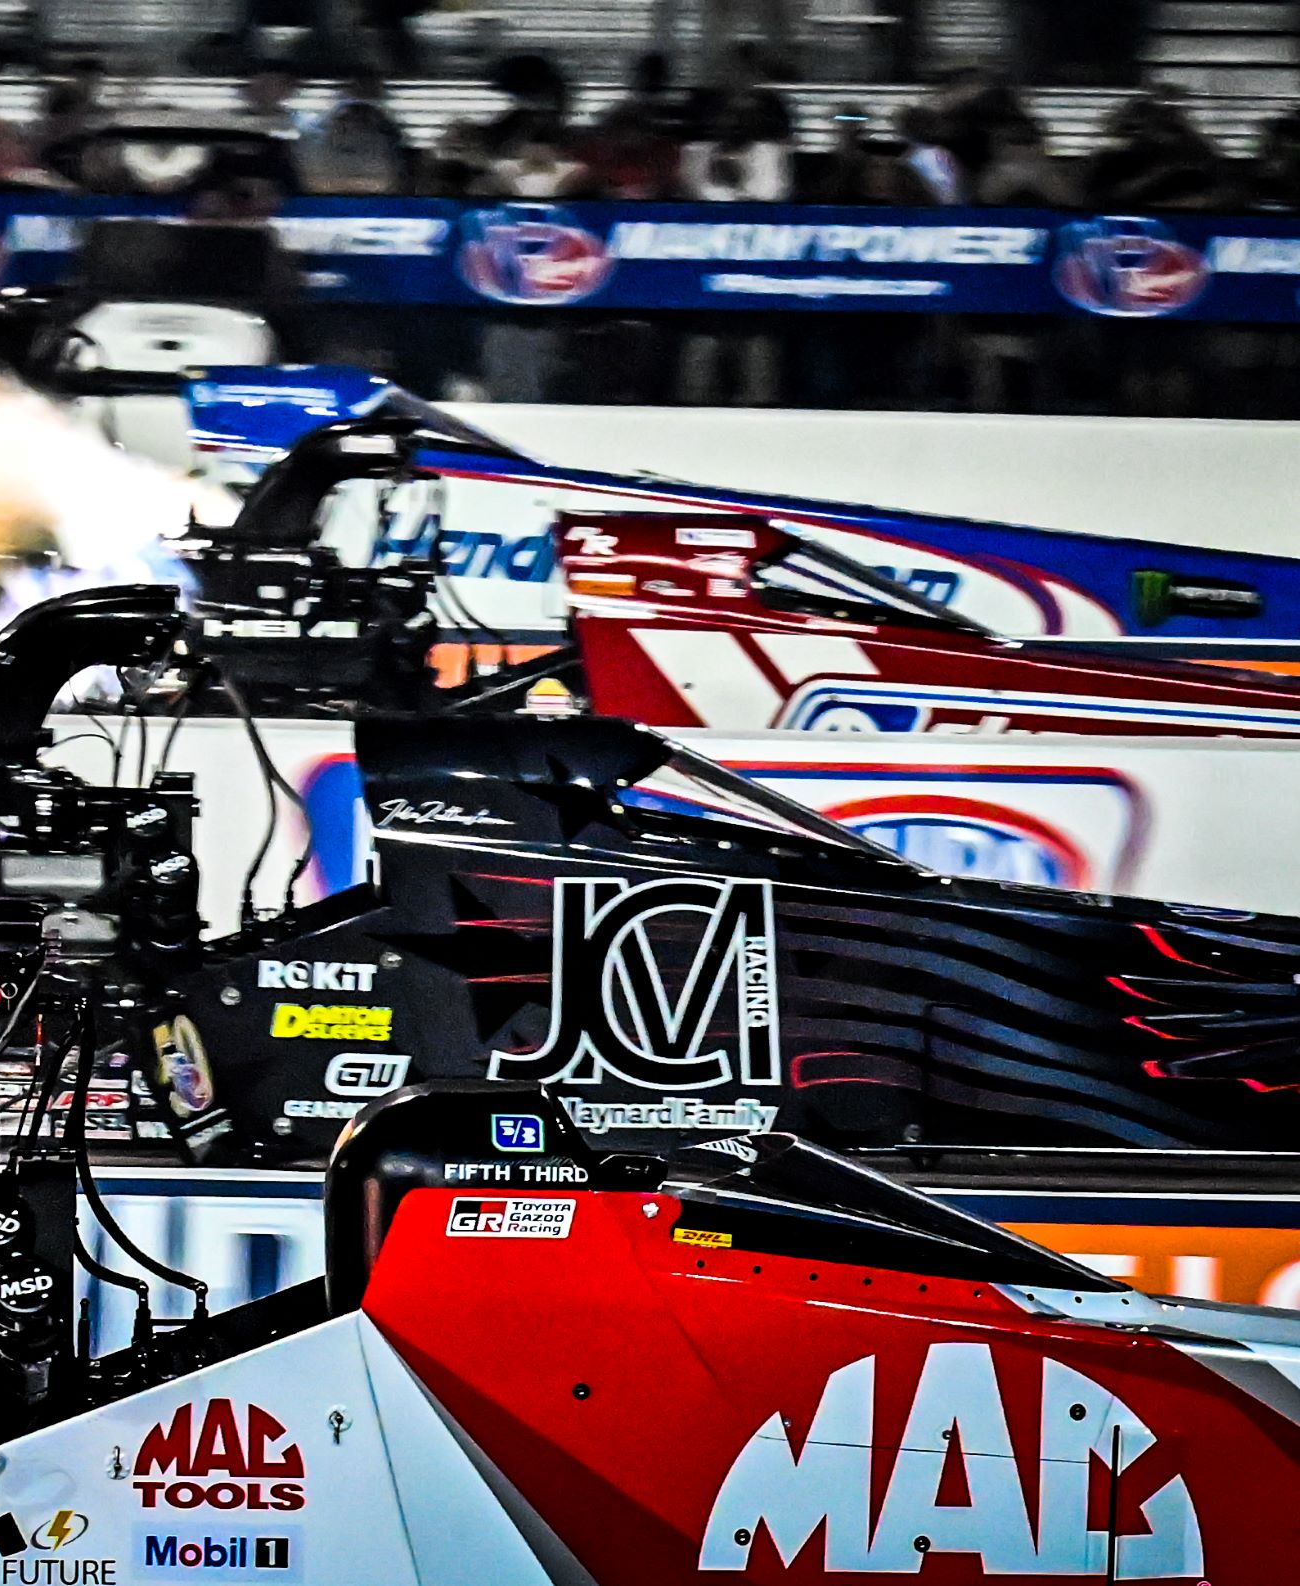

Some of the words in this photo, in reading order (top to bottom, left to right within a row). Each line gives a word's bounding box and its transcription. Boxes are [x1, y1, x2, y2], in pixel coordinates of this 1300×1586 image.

[744, 936, 770, 1028] RACING
[444, 1163, 511, 1182] FIFTH
[519, 1165, 589, 1183] THIRD
[509, 1212, 565, 1223] GAZOO
[511, 1201, 571, 1212] TOYOTA
[451, 1212, 504, 1232] GR
[507, 1222, 562, 1236] Racing
[682, 1230, 724, 1243] DHL
[0, 1275, 53, 1299] MSD
[133, 1398, 305, 1479] MAC
[698, 1342, 1204, 1581] MAC
[132, 1481, 306, 1512] TOOLS
[145, 1535, 247, 1568] Mobil
[1, 1559, 117, 1586] FUTURE
